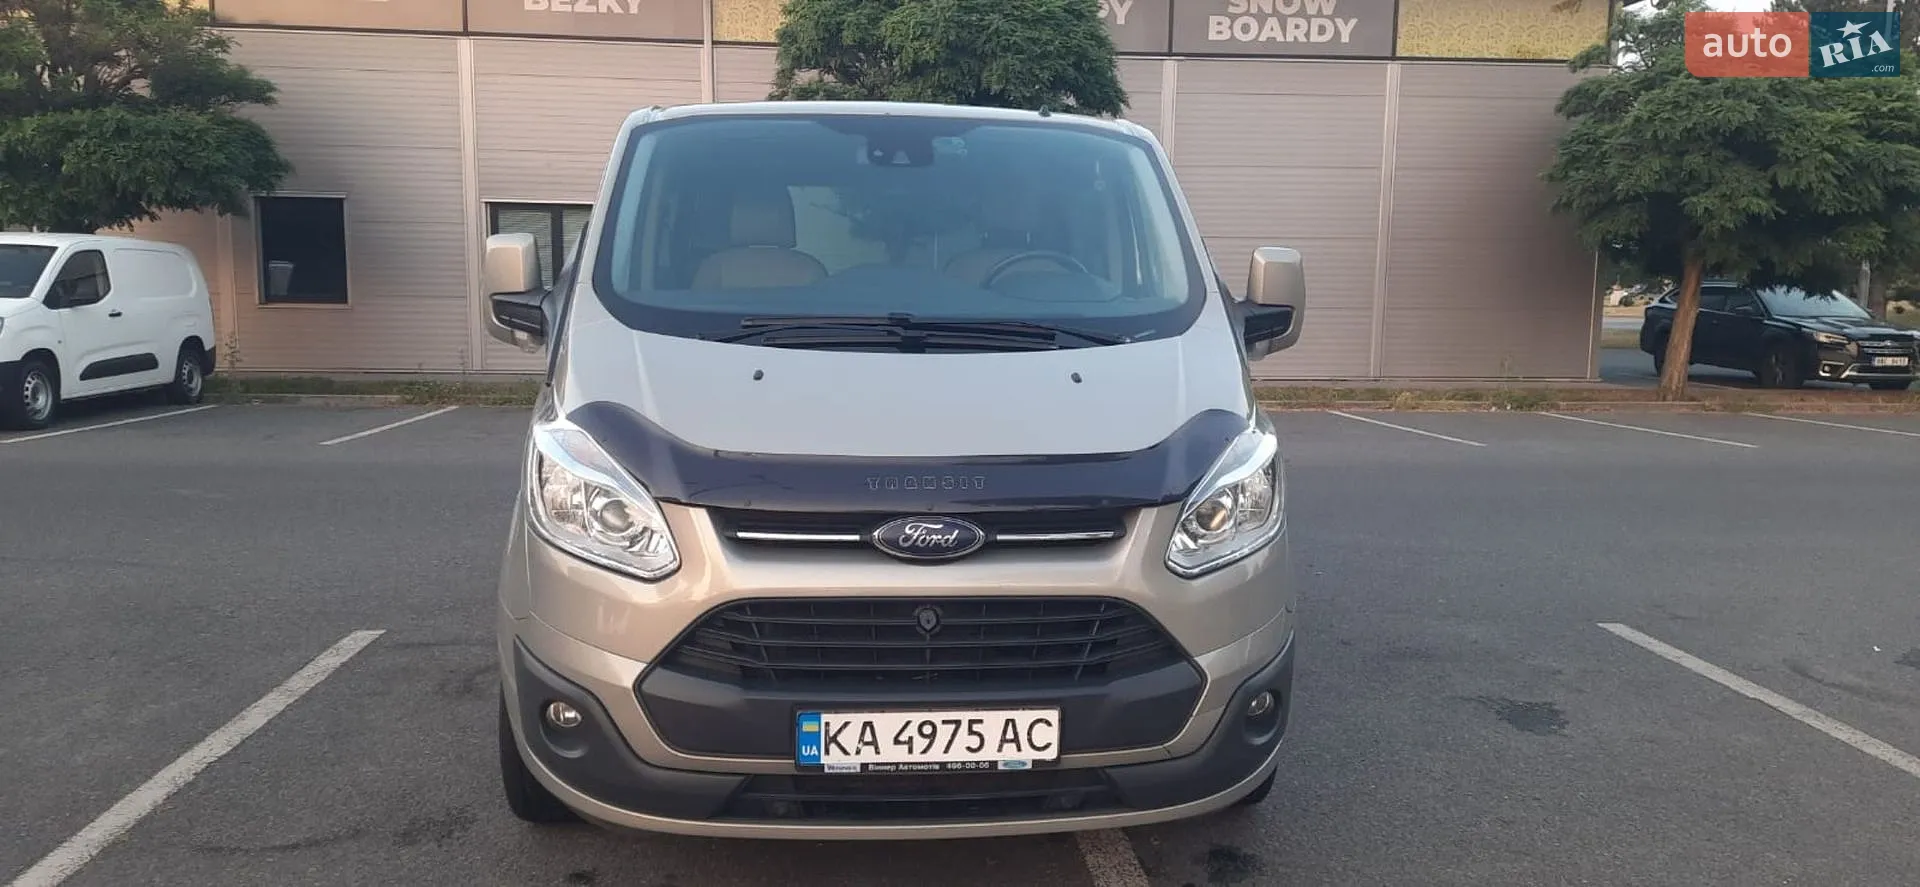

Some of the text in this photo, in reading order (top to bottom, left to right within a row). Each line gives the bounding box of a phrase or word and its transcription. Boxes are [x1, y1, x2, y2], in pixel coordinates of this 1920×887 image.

[1227, 0, 1337, 15] SNOW
[1208, 15, 1358, 43] BOARDY
[864, 475, 985, 490] TRANSIT
[898, 522, 959, 547] Ford
[824, 717, 1053, 756] KA 4975 AC
[802, 744, 819, 756] UA
